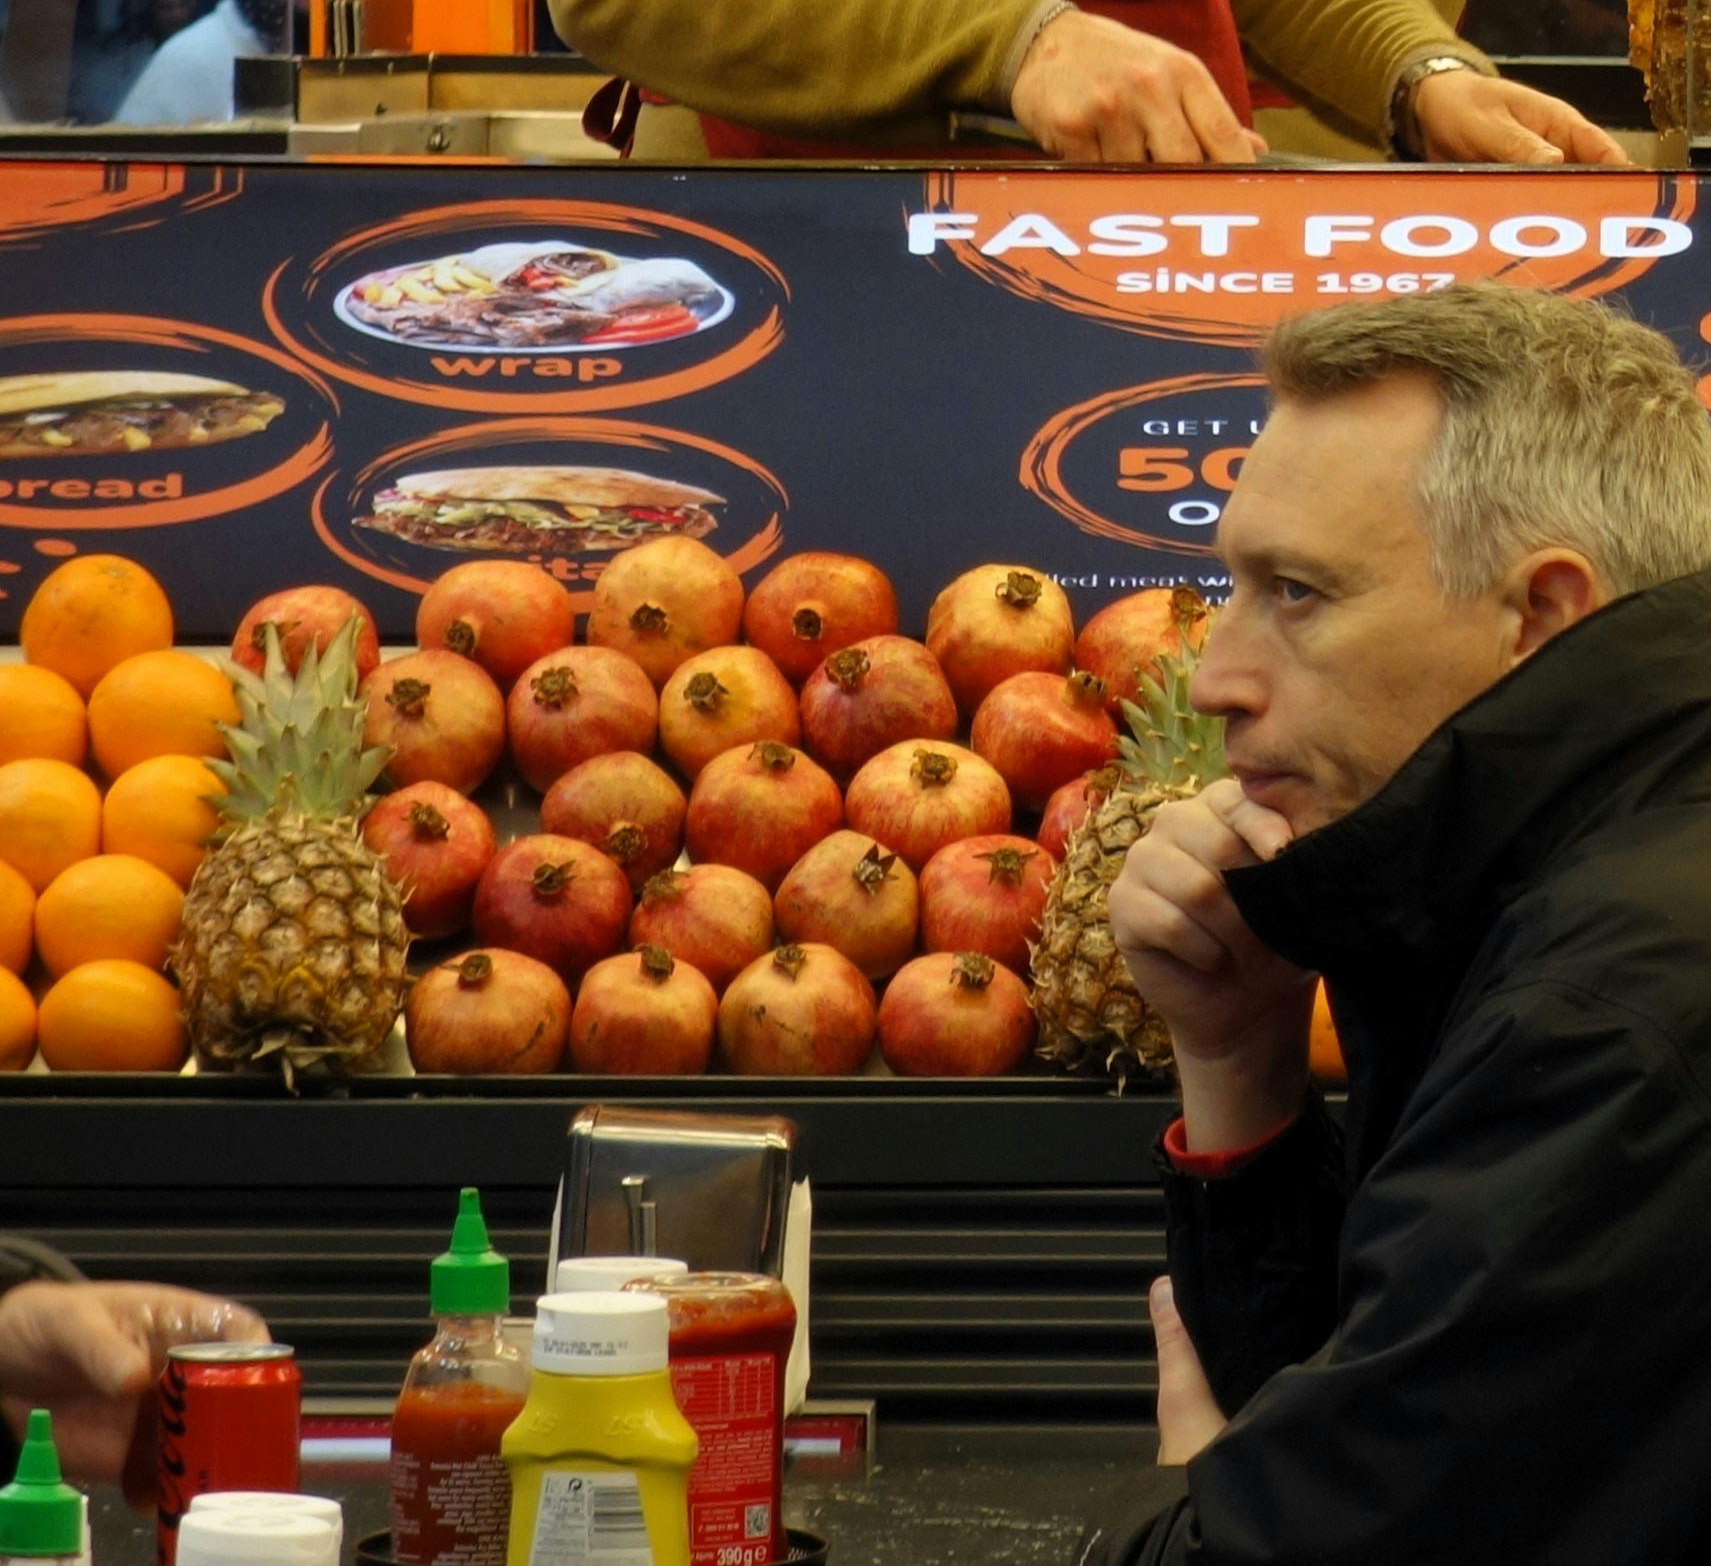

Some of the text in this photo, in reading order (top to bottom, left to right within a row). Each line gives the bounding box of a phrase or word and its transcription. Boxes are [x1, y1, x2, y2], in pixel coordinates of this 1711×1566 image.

[908, 214, 1694, 258] FAST FOOD
[1317, 273, 1455, 293] 1967
[430, 355, 623, 381] wrap
[1143, 420, 1228, 435] GET
[717, 1545, 743, 1566] 390
